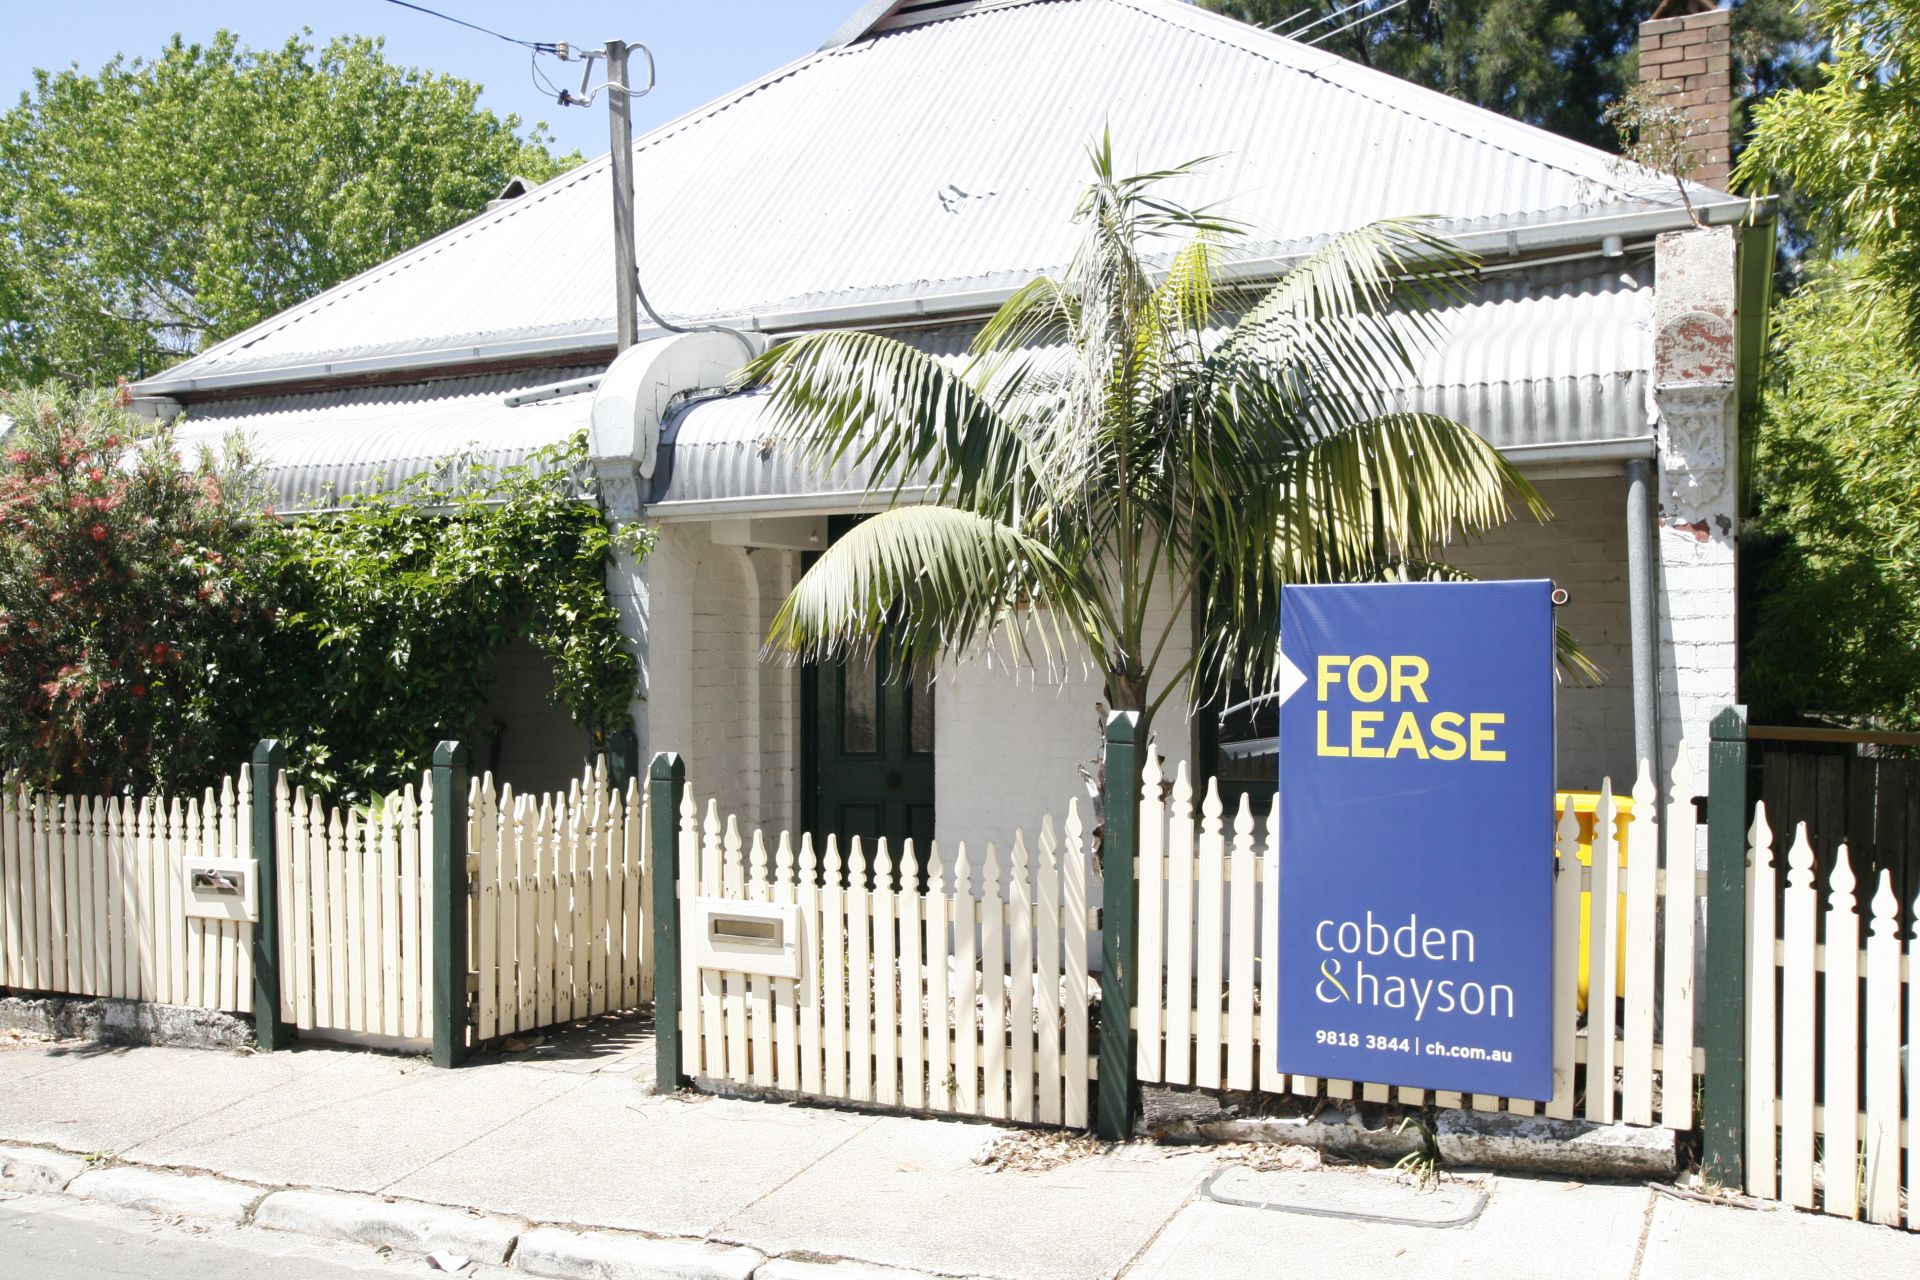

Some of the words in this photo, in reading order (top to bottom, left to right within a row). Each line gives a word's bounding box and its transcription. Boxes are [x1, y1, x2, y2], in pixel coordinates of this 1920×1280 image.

[1316, 654, 1430, 704] FOR
[1316, 709, 1507, 762] LEASE
[1315, 910, 1475, 963] cobden
[1315, 1029, 1360, 1048] 9818
[1365, 1034, 1411, 1053] 3844
[1425, 1041, 1513, 1064] ch.com.au
